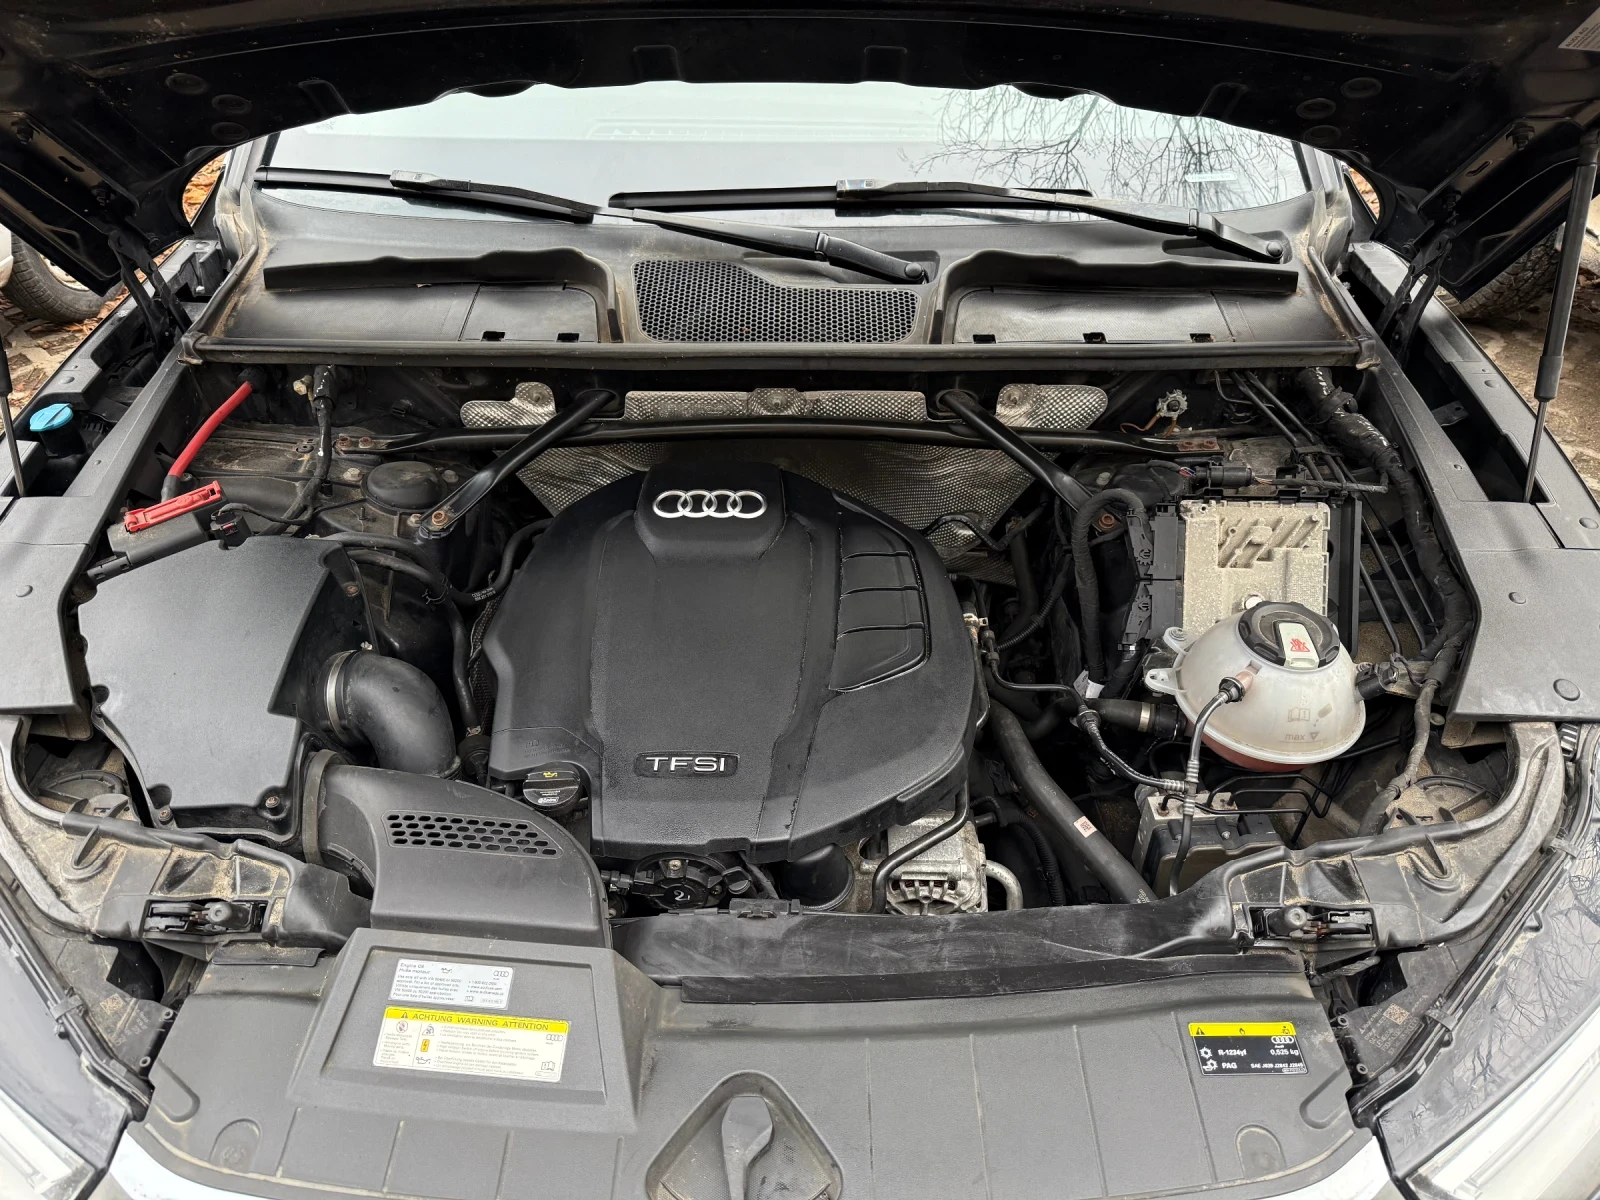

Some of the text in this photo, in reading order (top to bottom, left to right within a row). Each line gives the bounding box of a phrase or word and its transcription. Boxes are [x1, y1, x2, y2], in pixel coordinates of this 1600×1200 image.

[1284, 733, 1306, 741] max
[645, 757, 725, 772] TFSI
[412, 1013, 453, 1023] ACHTUNG
[457, 1016, 498, 1027] WARNING
[501, 1021, 549, 1031] ATTENTION
[1218, 1049, 1247, 1057] R-1234yf
[1289, 1049, 1299, 1057] kg
